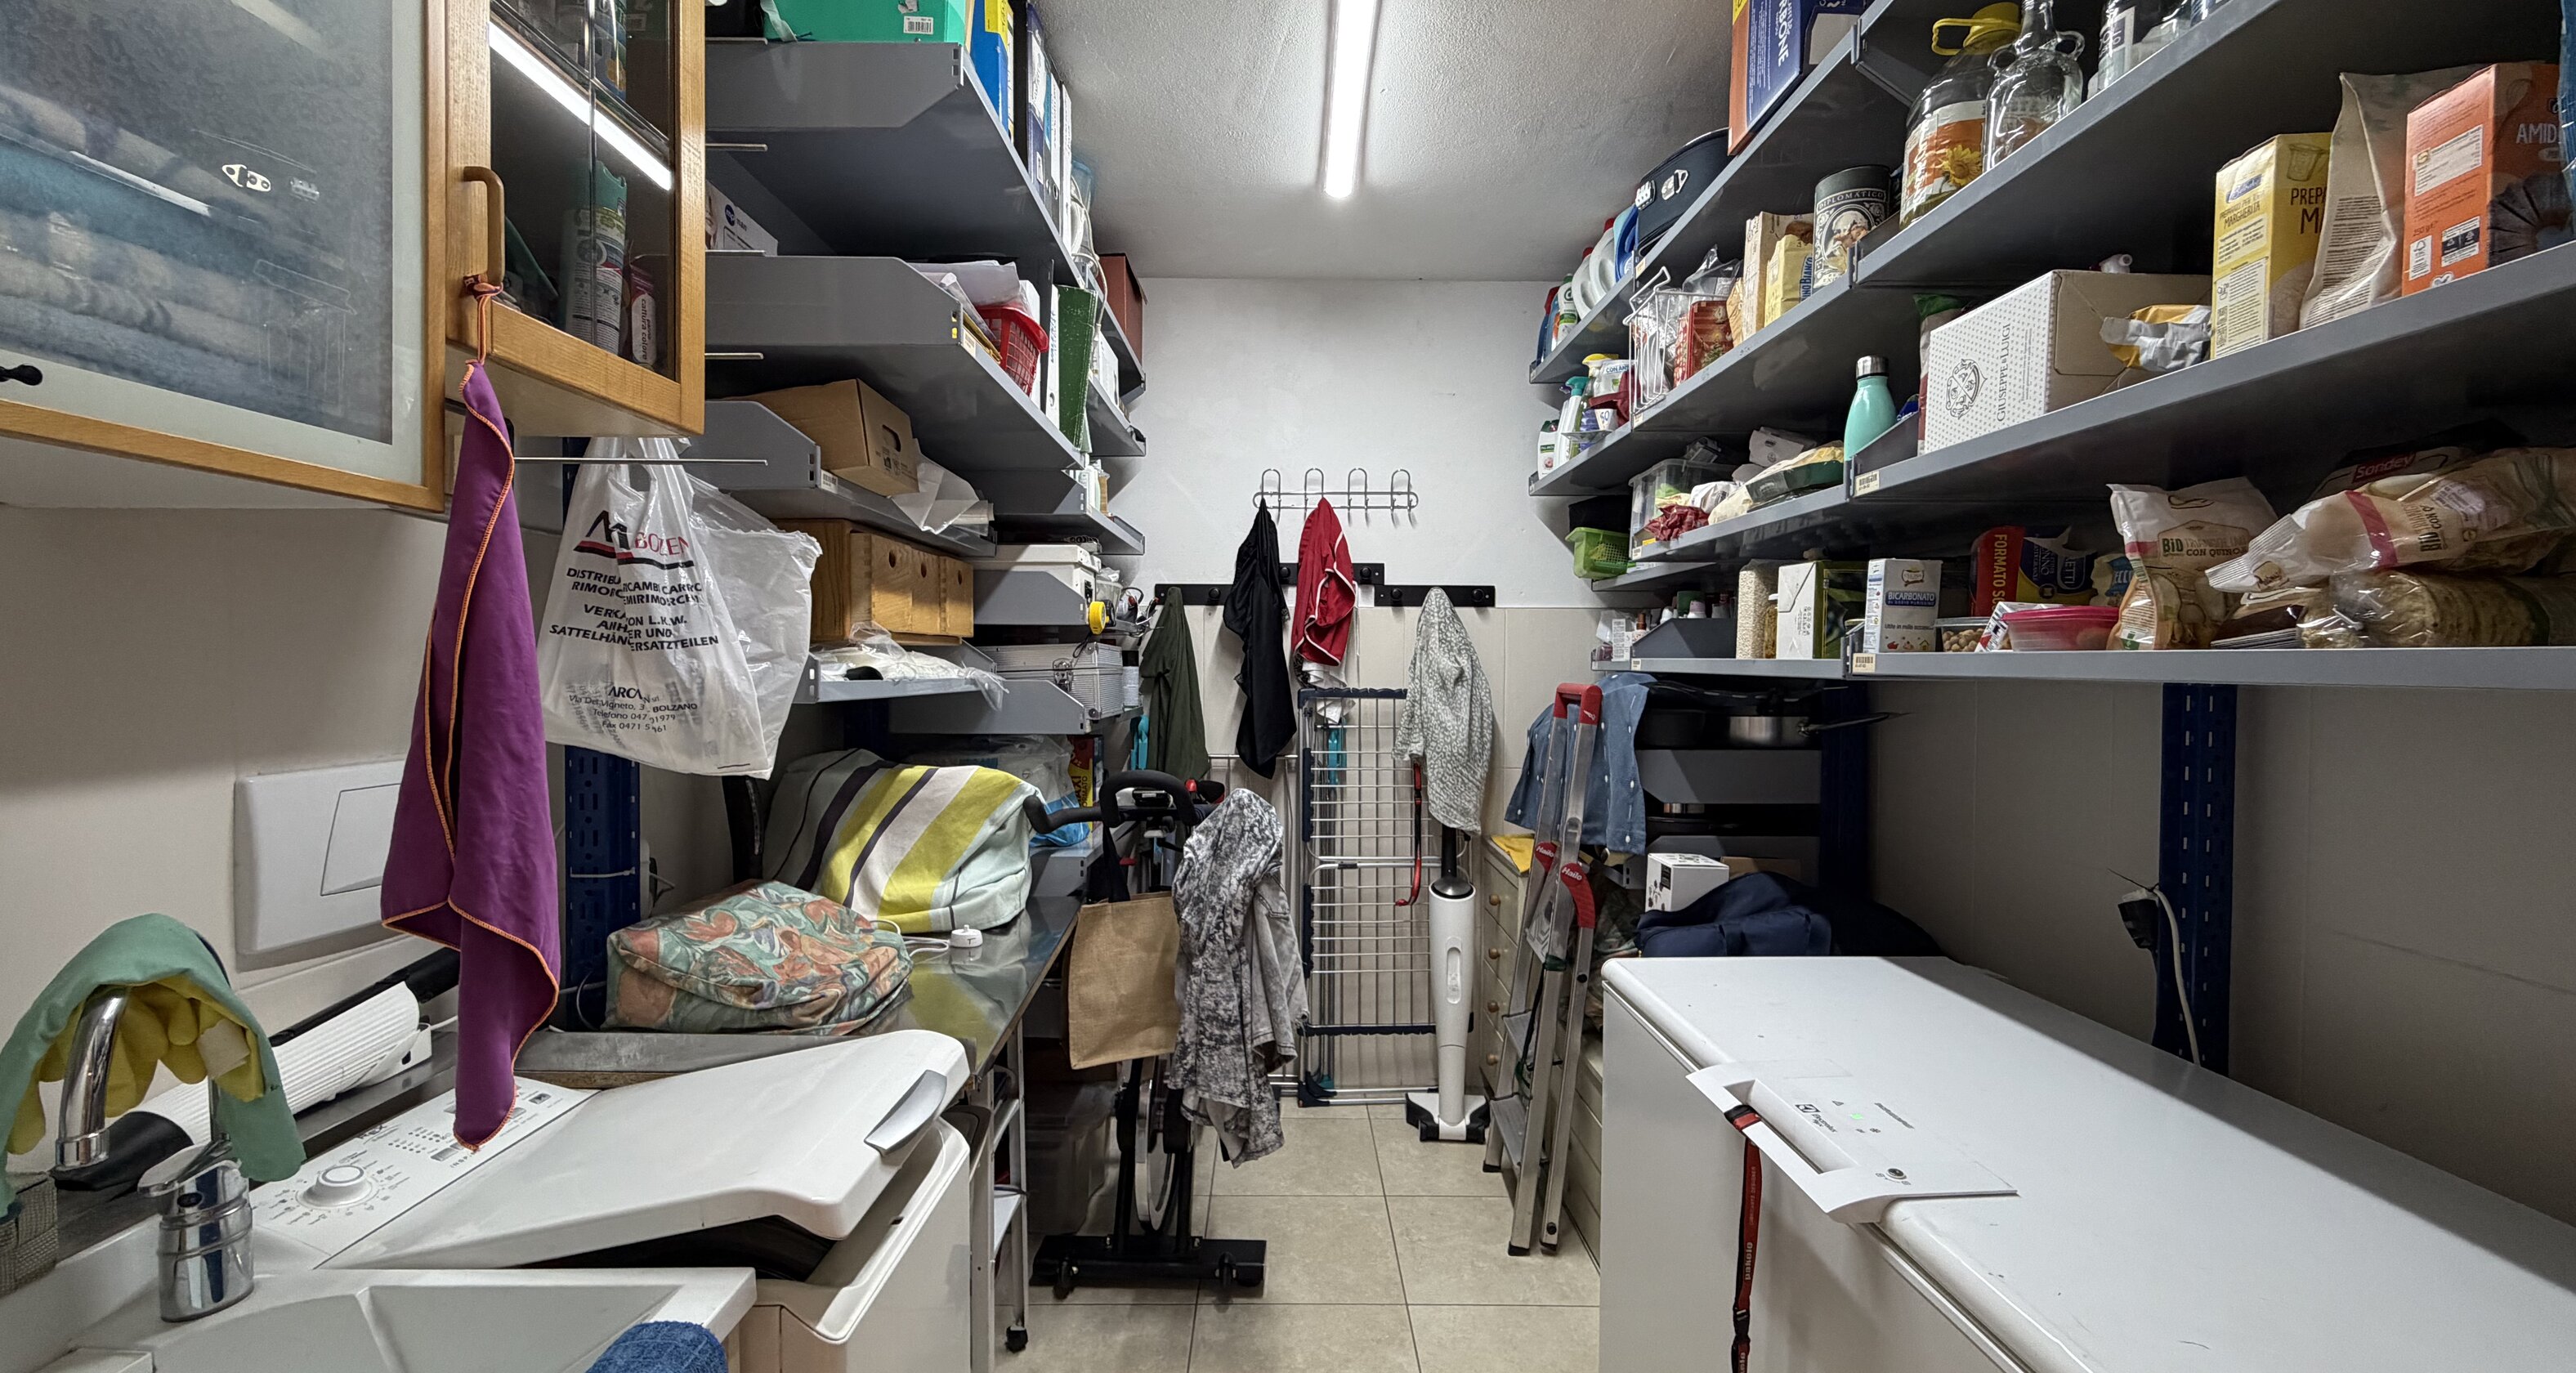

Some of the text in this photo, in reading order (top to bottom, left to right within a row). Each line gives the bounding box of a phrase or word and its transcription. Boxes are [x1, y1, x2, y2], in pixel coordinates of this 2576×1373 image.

[2516, 123, 2560, 144] AMID
[2300, 208, 2322, 234] M
[2000, 324, 2011, 360] LUIGI
[1997, 364, 2010, 422] GIUSEPPE
[2355, 455, 2411, 480] Sondey
[2186, 548, 2207, 557] CON
[1992, 534, 2007, 587] FORMATO
[1888, 592, 1934, 602] BICARBONATO
[646, 628, 673, 638] UND
[593, 709, 628, 720] Telefono
[653, 703, 698, 713] BOLZANO
[602, 720, 616, 729] Fax
[1536, 845, 1554, 857] Hailo
[1561, 866, 1583, 881] Hailo
[1745, 1241, 1754, 1281] pakelo
